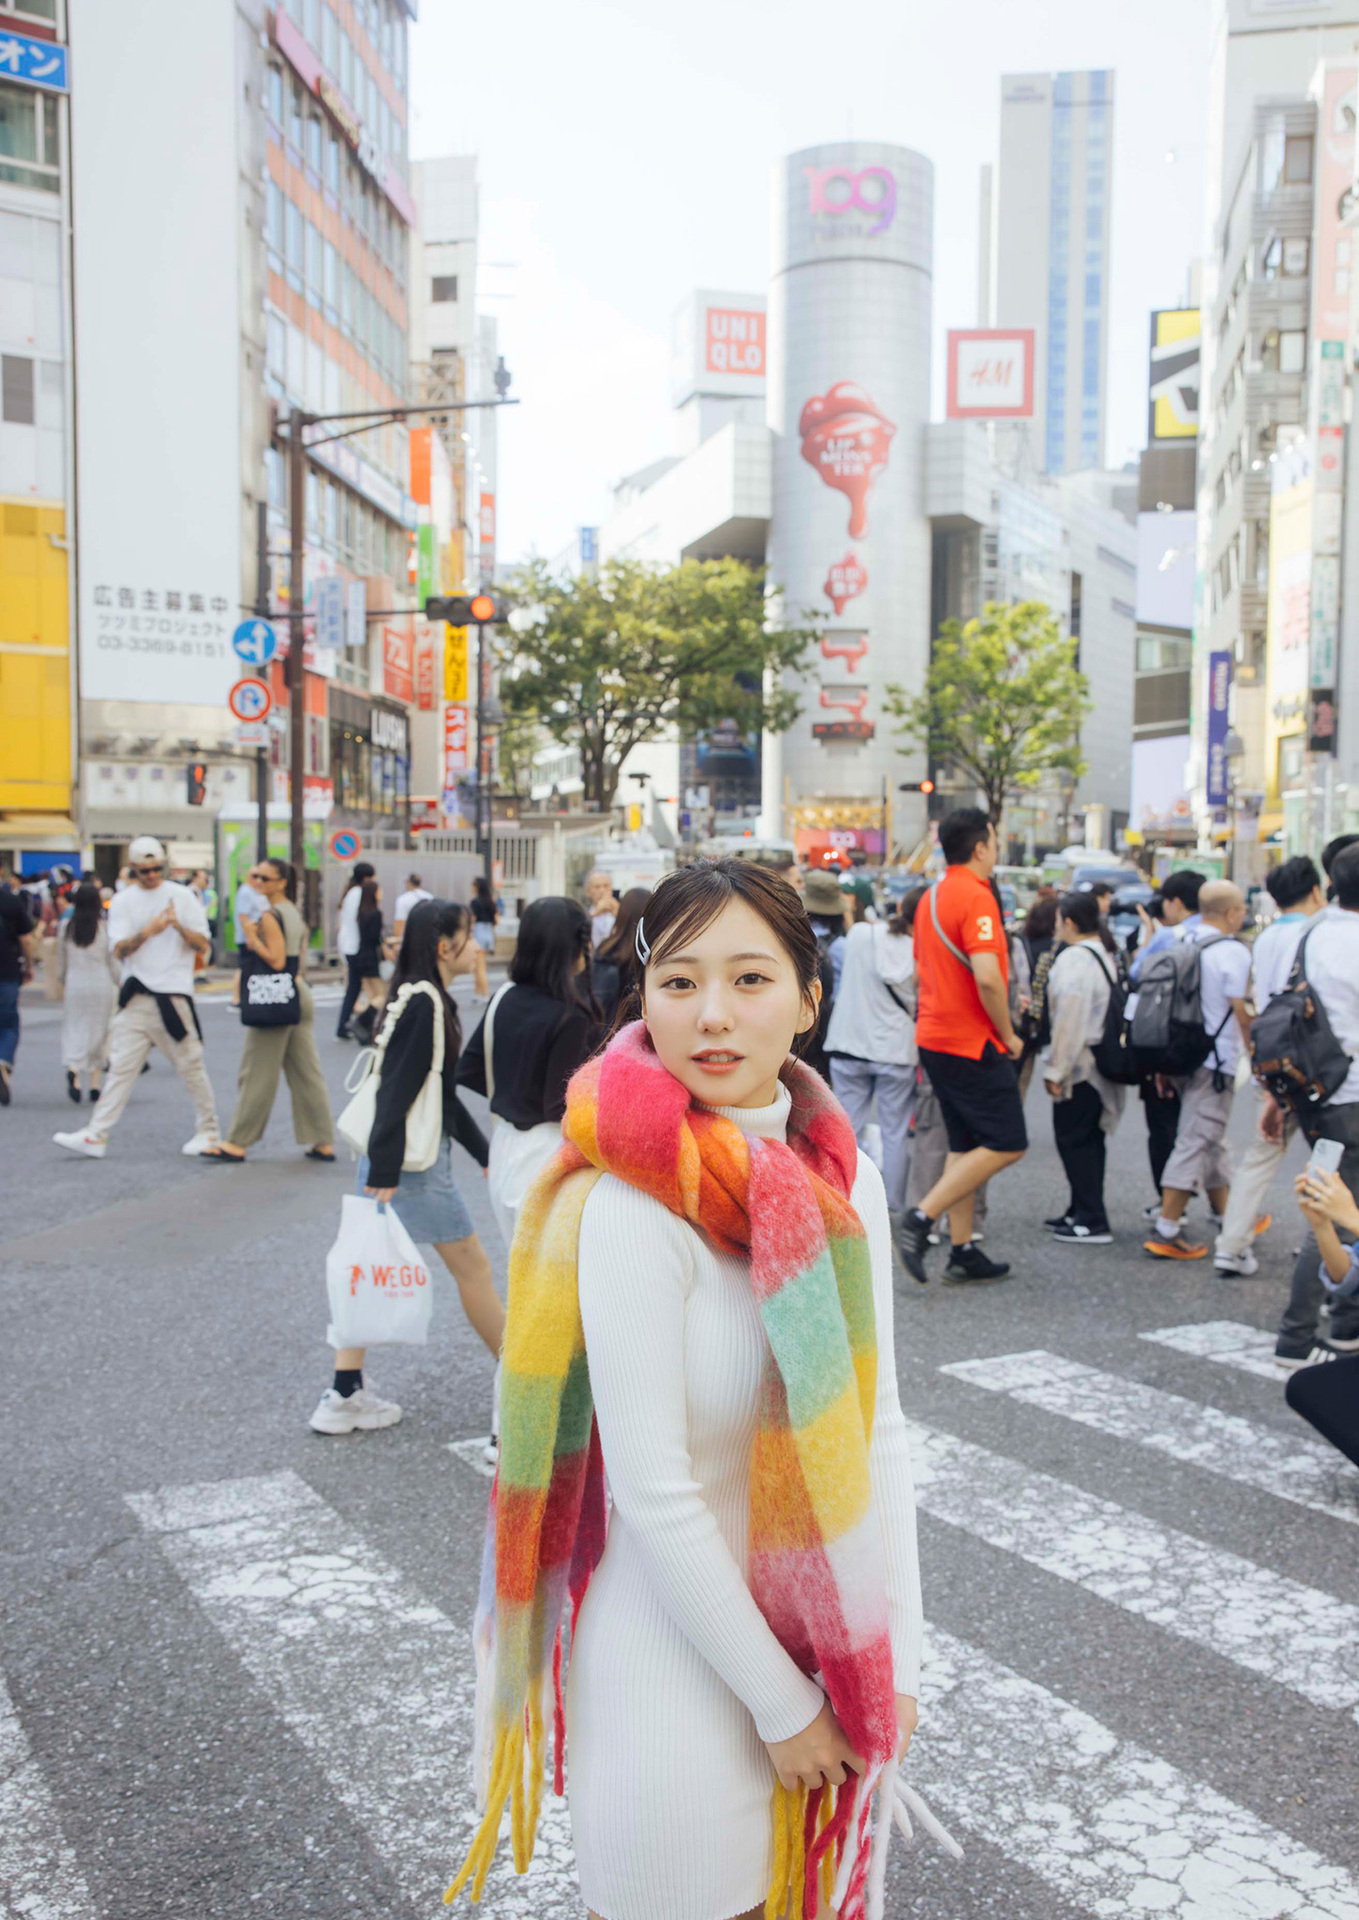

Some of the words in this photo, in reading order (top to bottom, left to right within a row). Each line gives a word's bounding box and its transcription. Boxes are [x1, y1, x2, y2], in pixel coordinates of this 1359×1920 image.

[802, 164, 898, 236] 109
[711, 314, 757, 342] UNI
[711, 342, 762, 372] QLO
[94, 585, 228, 614] 広告主募集中
[976, 915, 993, 940] 3
